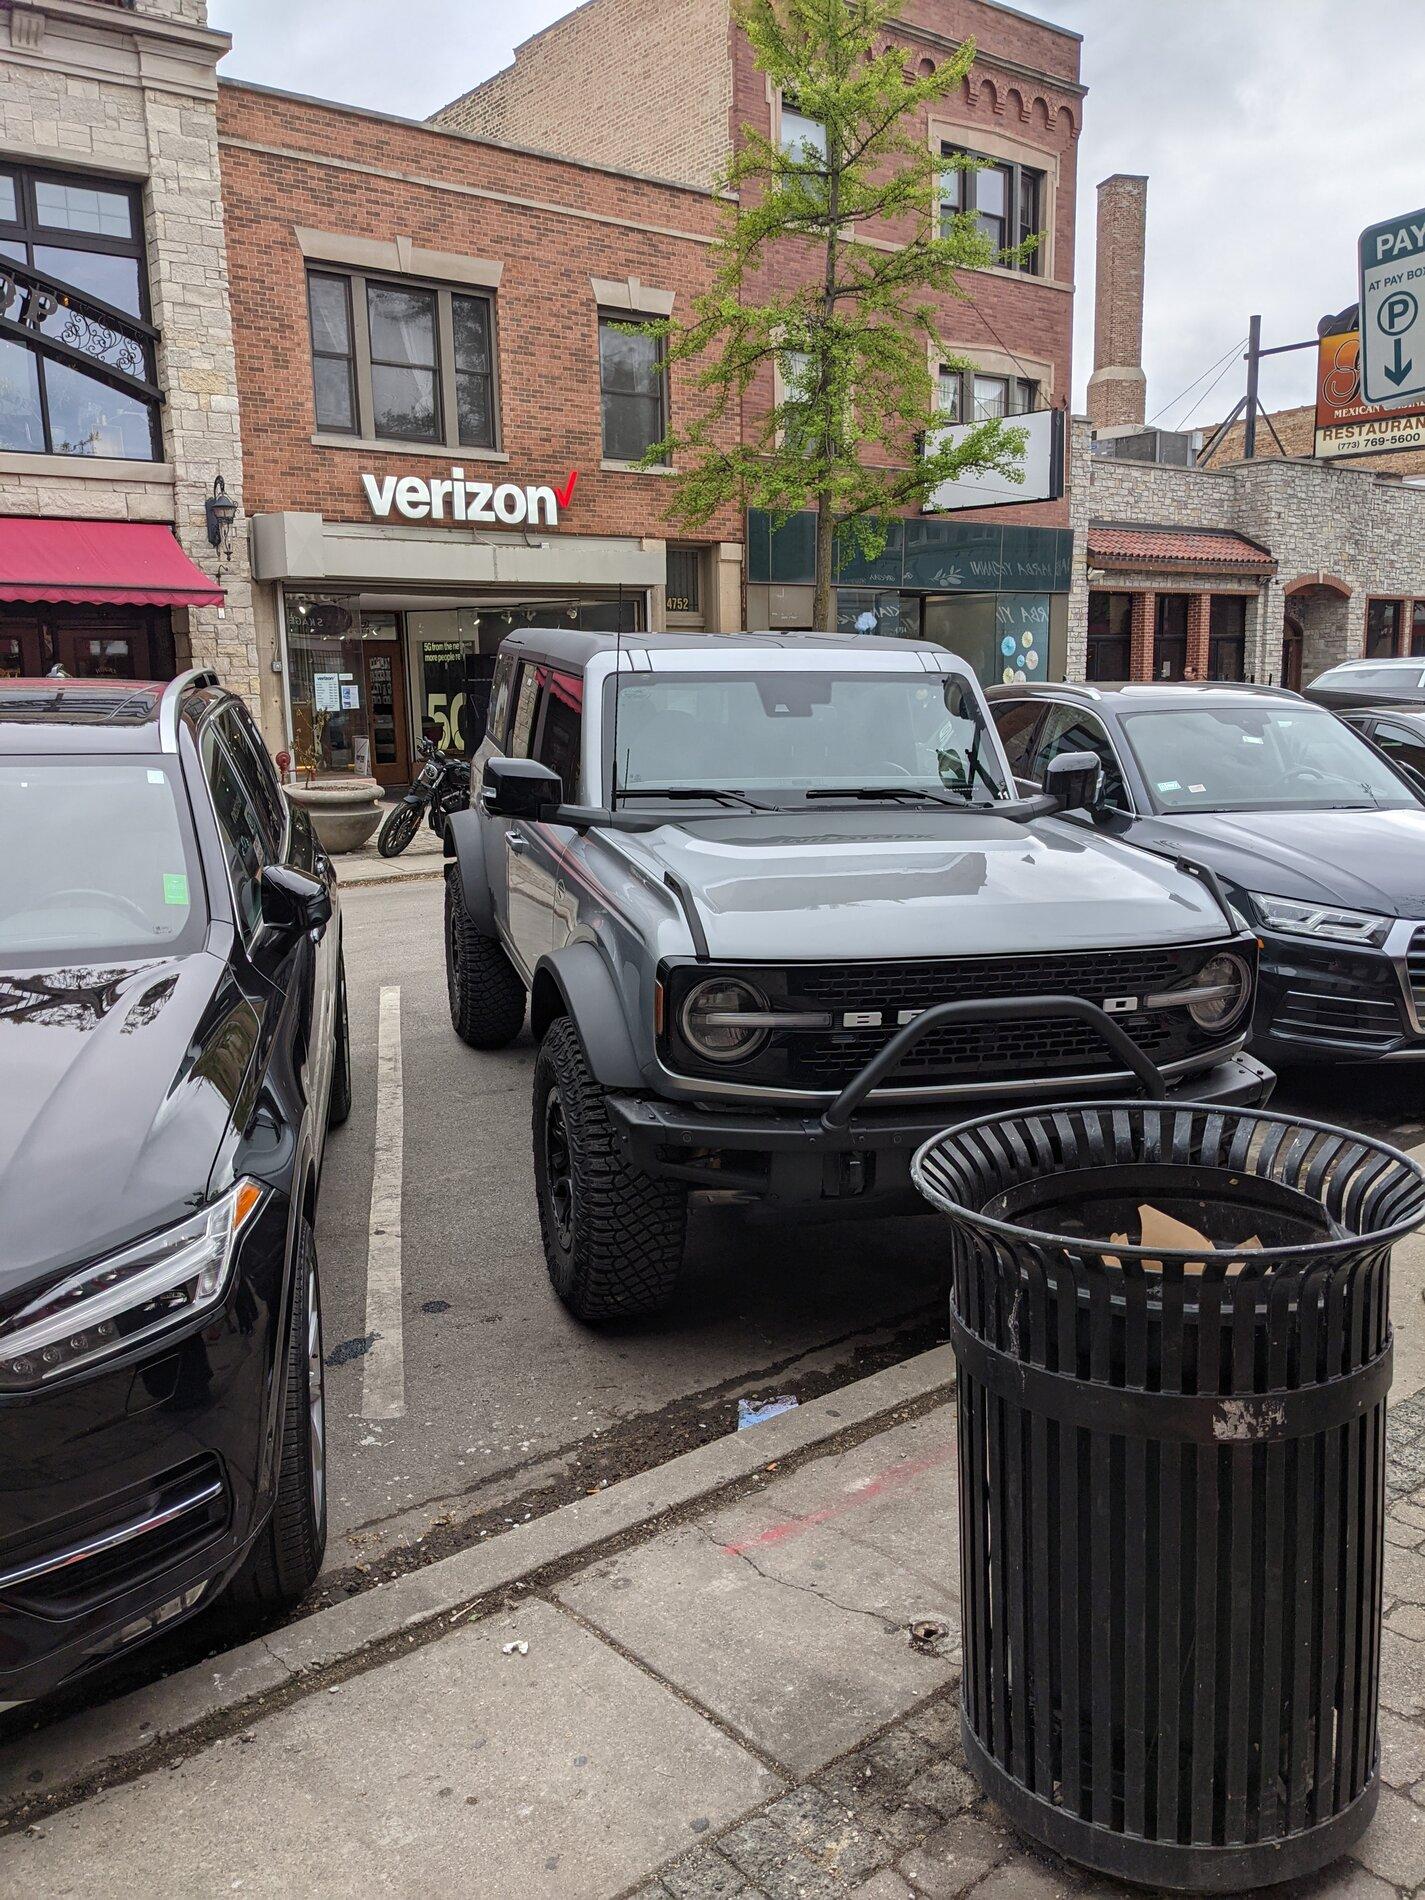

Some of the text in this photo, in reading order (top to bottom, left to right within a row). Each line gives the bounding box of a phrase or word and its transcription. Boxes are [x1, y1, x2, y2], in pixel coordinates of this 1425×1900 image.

[1376, 222, 1425, 260] PAY
[1368, 280, 1381, 292] AT
[1384, 273, 1404, 287] PAY
[1388, 298, 1410, 330] P
[1333, 404, 1380, 419] MEXICAN
[1322, 416, 1425, 442] RESTAURAN
[1337, 432, 1420, 451] (773) 769-5600
[361, 467, 558, 526] verizon
[666, 596, 689, 611] 4752
[425, 654, 437, 662] more
